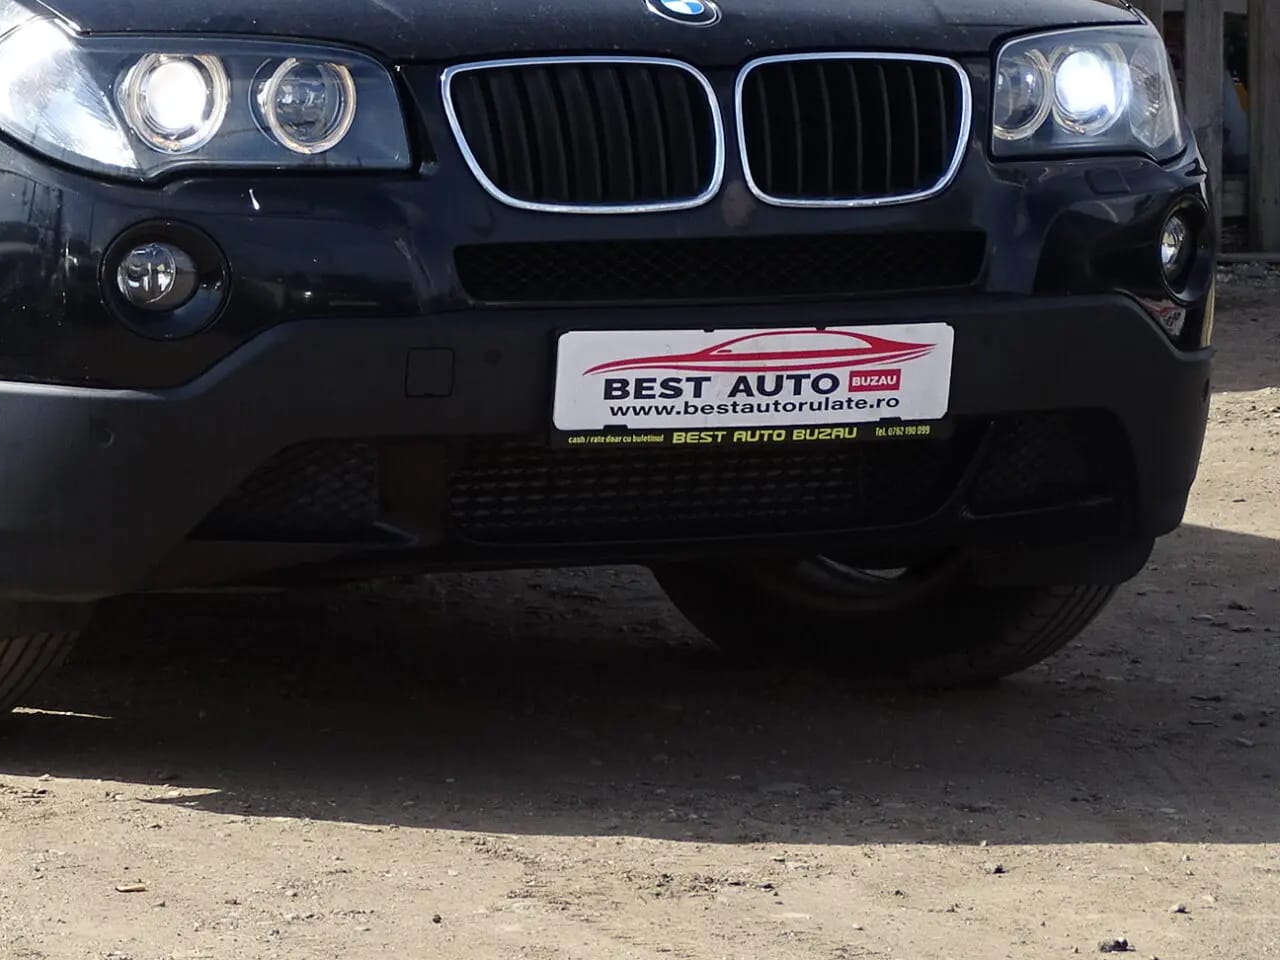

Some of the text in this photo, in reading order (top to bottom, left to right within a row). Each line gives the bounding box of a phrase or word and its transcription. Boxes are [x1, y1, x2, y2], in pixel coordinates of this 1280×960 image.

[604, 373, 897, 400] BEST AUTO BUZAU
[610, 396, 900, 417] www.bestautorulate.ro
[672, 431, 727, 444] BEST
[733, 429, 786, 442] AUTO
[792, 427, 858, 440] BUZAU
